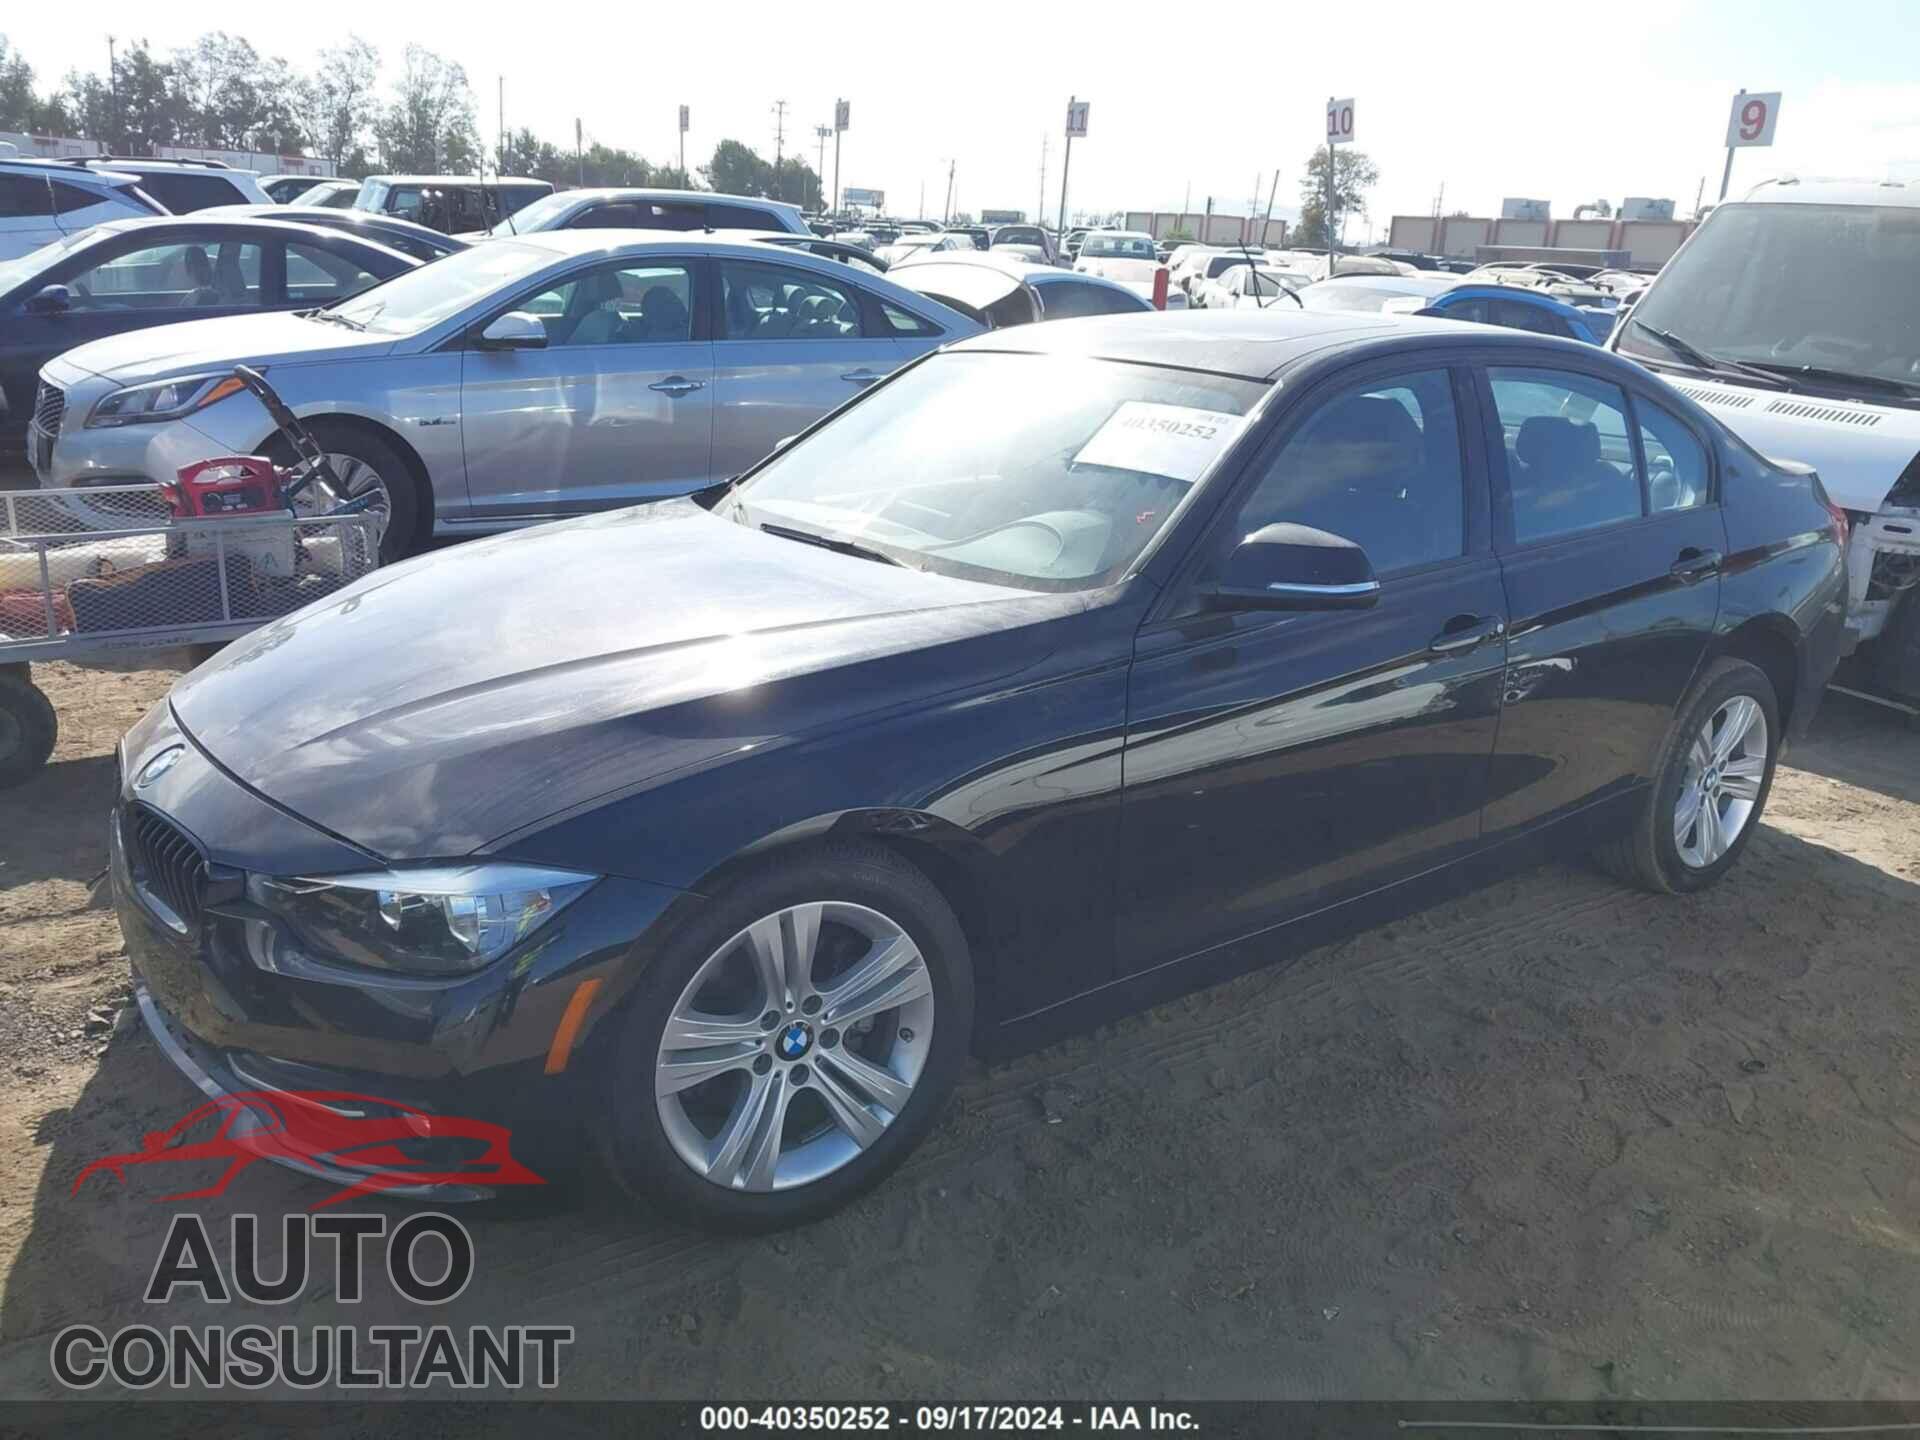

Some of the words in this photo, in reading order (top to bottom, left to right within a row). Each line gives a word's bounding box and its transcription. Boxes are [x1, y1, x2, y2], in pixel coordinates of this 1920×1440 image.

[1068, 107, 1087, 131] 11
[1327, 106, 1354, 136] 10
[1739, 99, 1767, 141] 9
